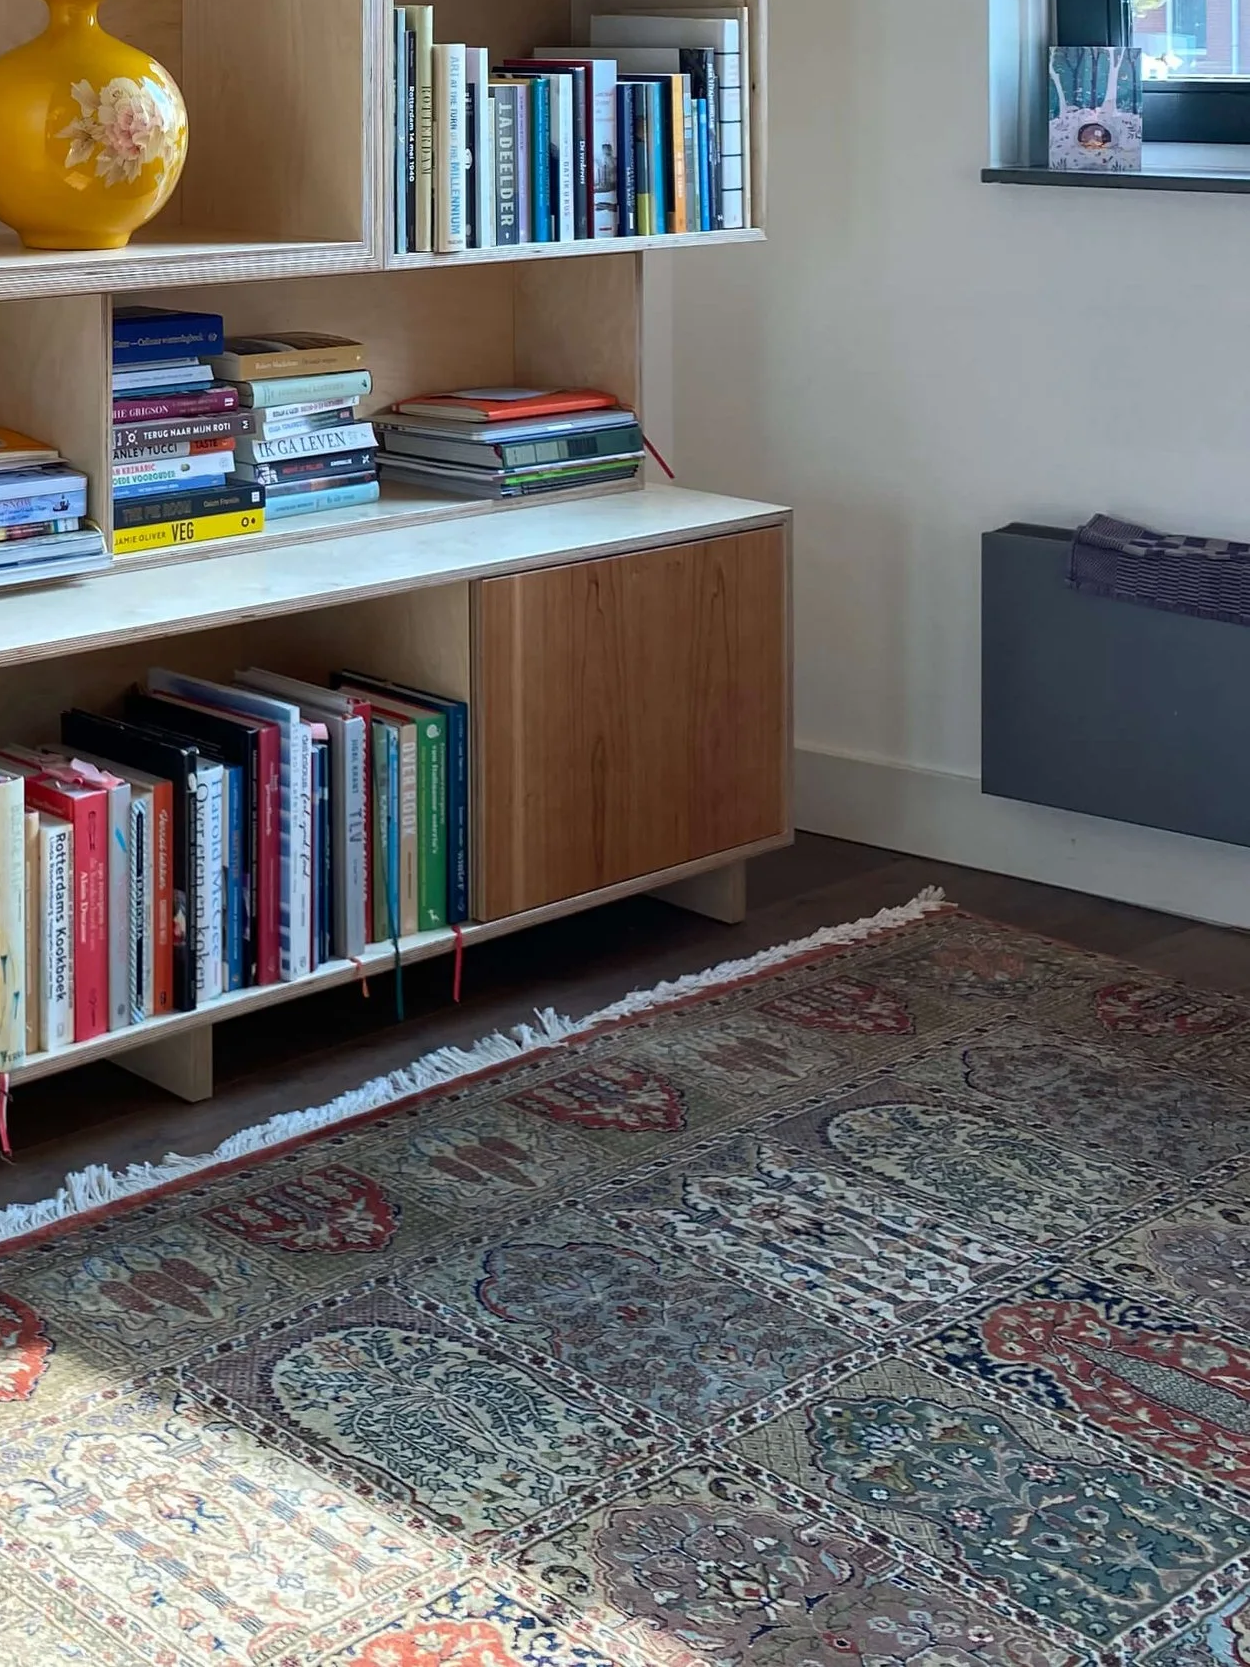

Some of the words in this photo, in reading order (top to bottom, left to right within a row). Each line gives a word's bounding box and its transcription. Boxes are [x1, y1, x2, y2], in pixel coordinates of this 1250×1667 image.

[409, 133, 414, 142] 14
[421, 85, 432, 175] ROTTERDAM
[450, 108, 458, 130] TURN
[450, 162, 460, 235] MILLENNIUM
[129, 405, 170, 418] GRIGSON
[143, 431, 168, 440] TERUG
[170, 428, 191, 437] NAAR
[193, 424, 211, 435] MIJN
[213, 422, 231, 431] ROTI
[148, 443, 178, 455] TUCCI
[195, 439, 219, 449] TASTE
[257, 441, 275, 458] IK
[277, 439, 298, 455] GA
[300, 431, 347, 452] LEVEN
[115, 536, 138, 546] JAMIE
[139, 531, 166, 542] OLIVER
[172, 521, 194, 542] VEG
[402, 742, 416, 787] OVER
[196, 783, 208, 837] Over
[211, 778, 222, 866] Harold
[349, 808, 362, 843] TLV
[403, 791, 416, 840] ROOK
[55, 832, 66, 922] Rotterdams
[196, 844, 207, 885] eten
[80, 871, 88, 900] Alain
[196, 890, 206, 913] en
[212, 870, 222, 957] McGee
[56, 929, 67, 1002] Kookboek
[195, 926, 209, 990] koken
